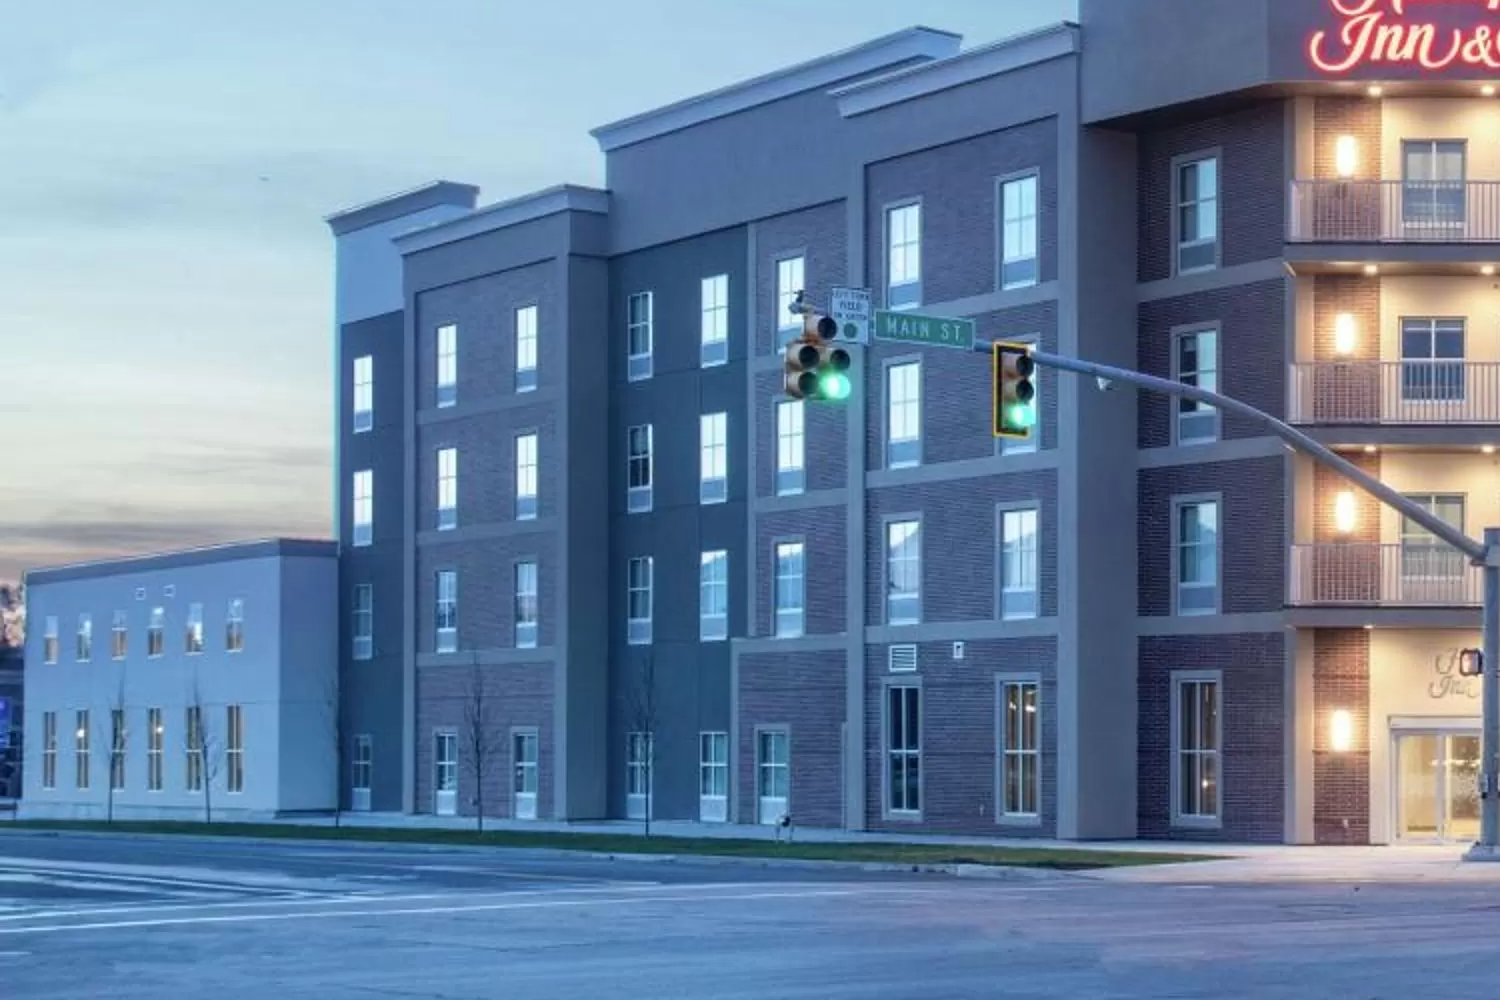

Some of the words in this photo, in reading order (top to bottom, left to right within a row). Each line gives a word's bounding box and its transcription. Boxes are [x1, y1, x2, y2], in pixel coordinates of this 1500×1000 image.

[1310, 11, 1461, 72] Inn
[1462, 25, 1500, 67] &
[887, 314, 929, 338] MAIN
